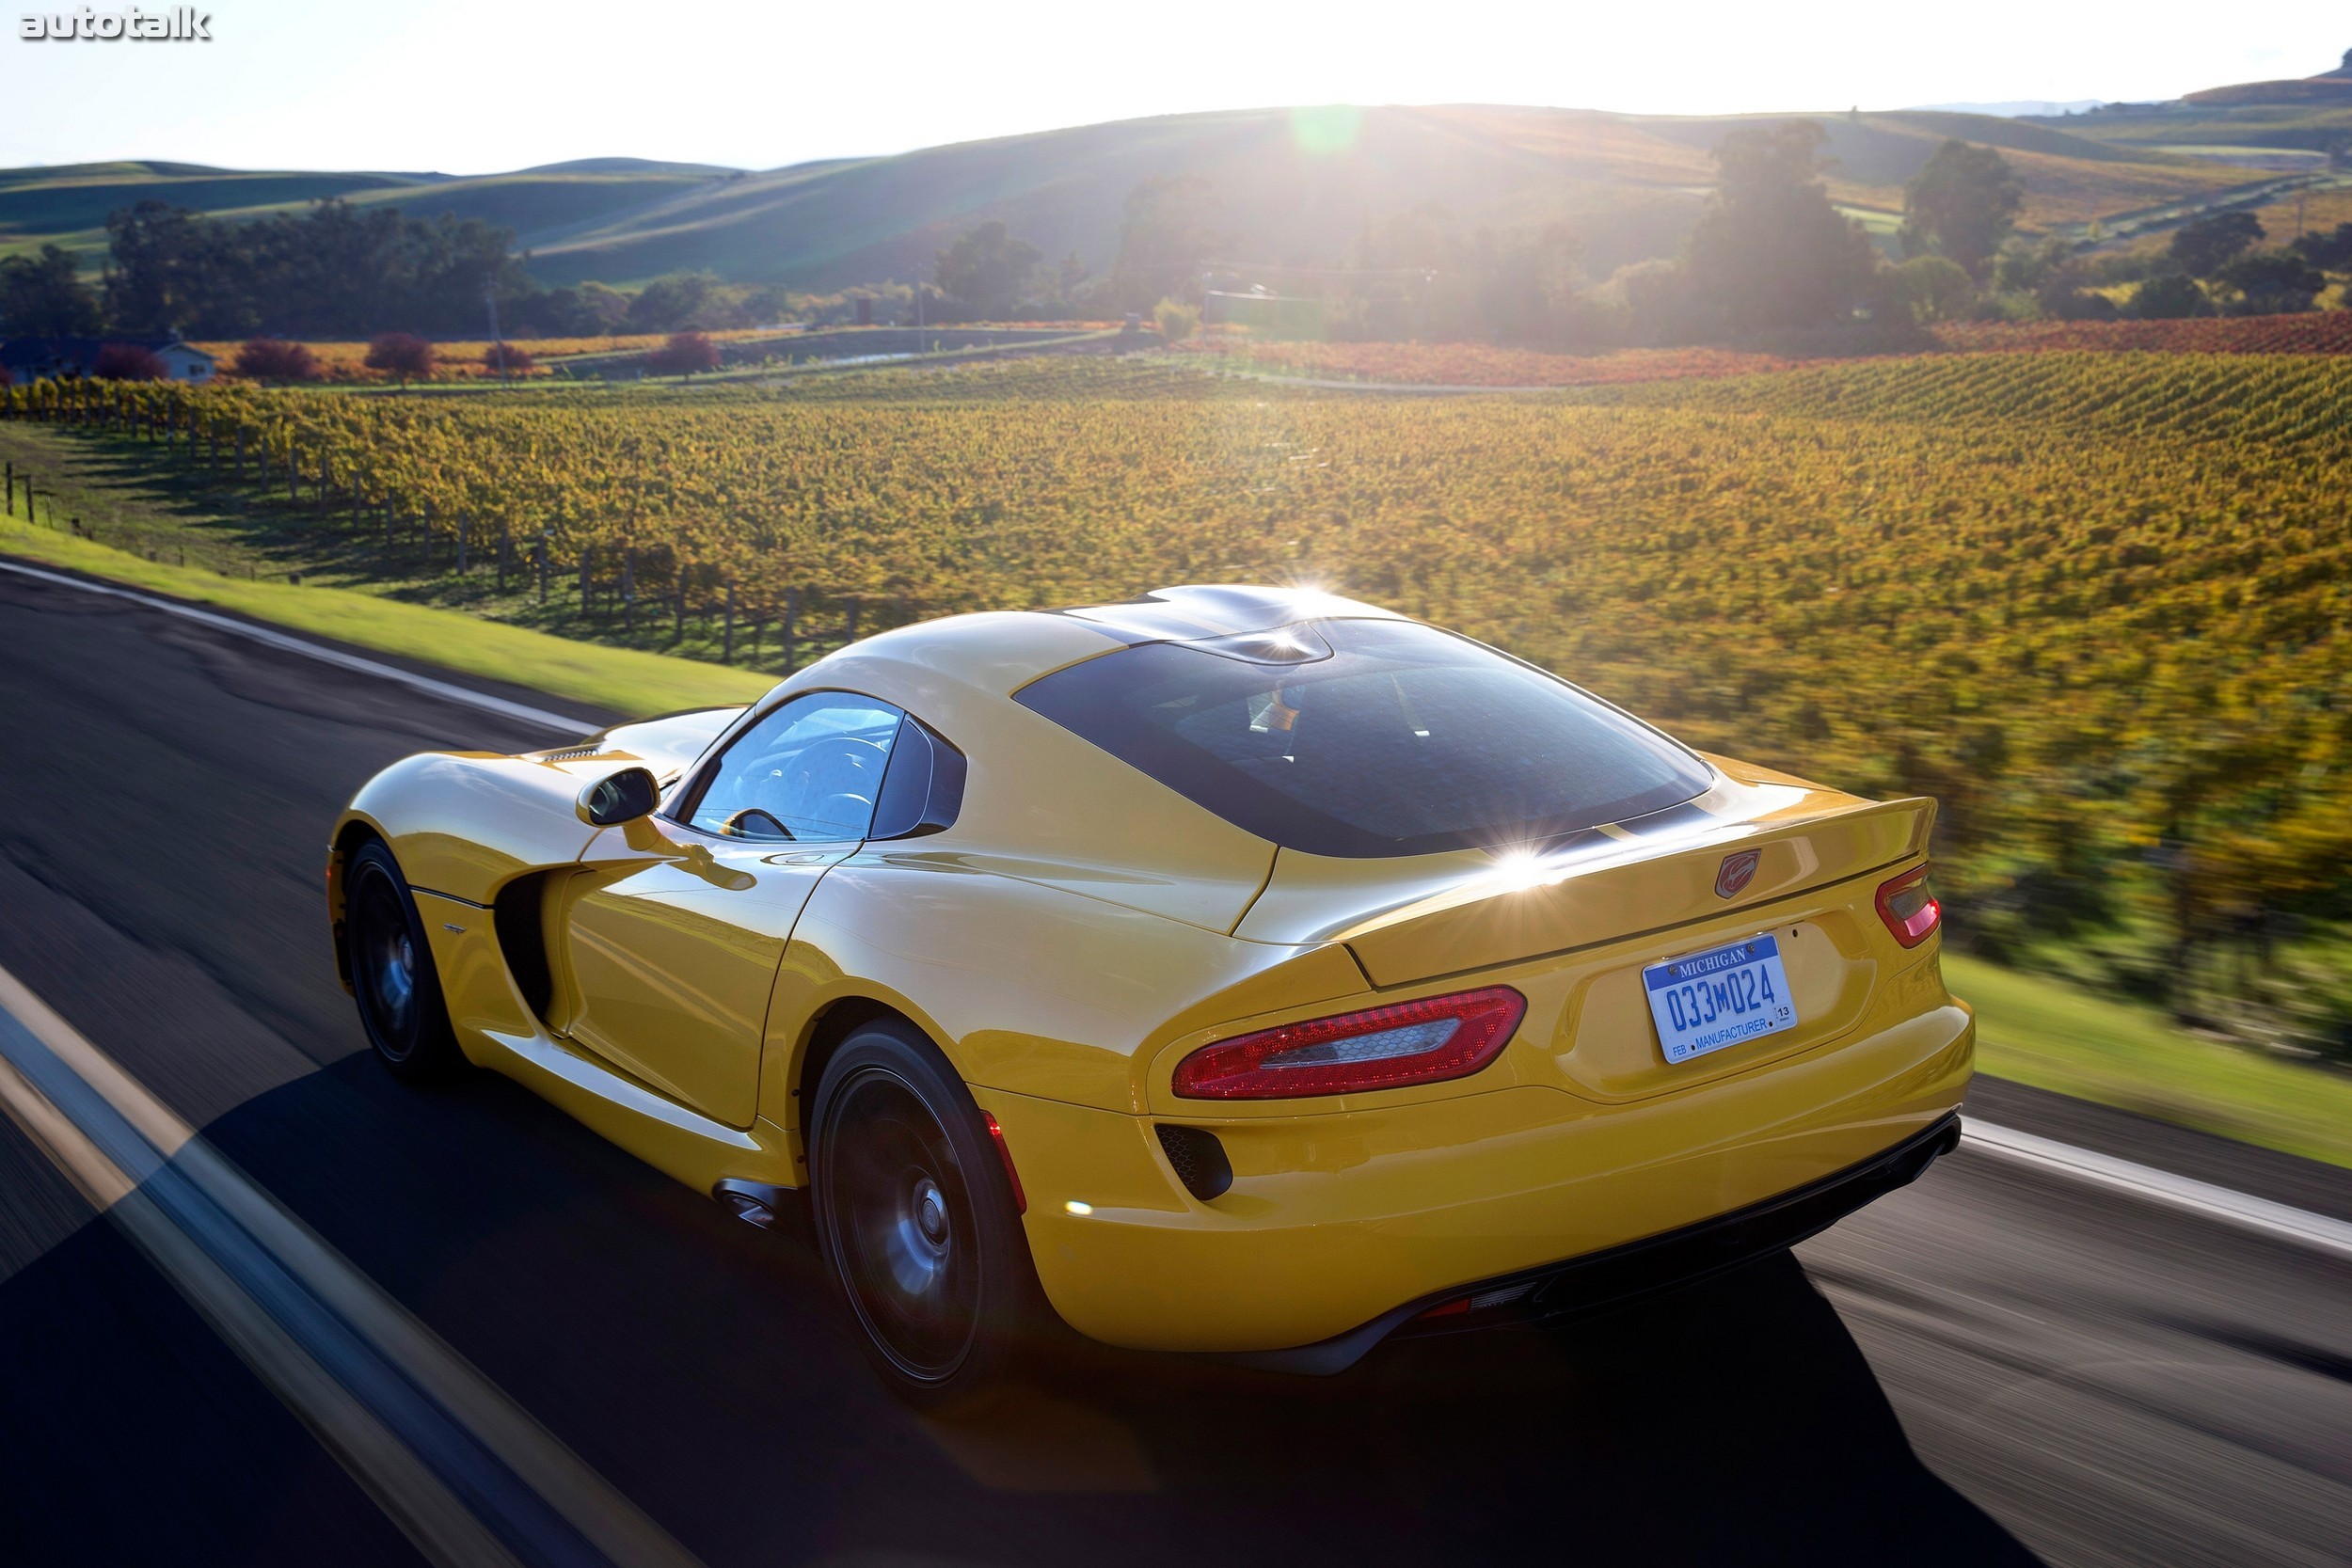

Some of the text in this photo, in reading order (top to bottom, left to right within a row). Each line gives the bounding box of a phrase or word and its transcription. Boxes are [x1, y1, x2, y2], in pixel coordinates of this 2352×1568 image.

[1679, 948, 1746, 978] MICHIGAN
[1666, 963, 1775, 1032] 033M024
[1777, 1006, 1789, 1017] 13
[1673, 1018, 1768, 1056] FEB MANUFACTURER
